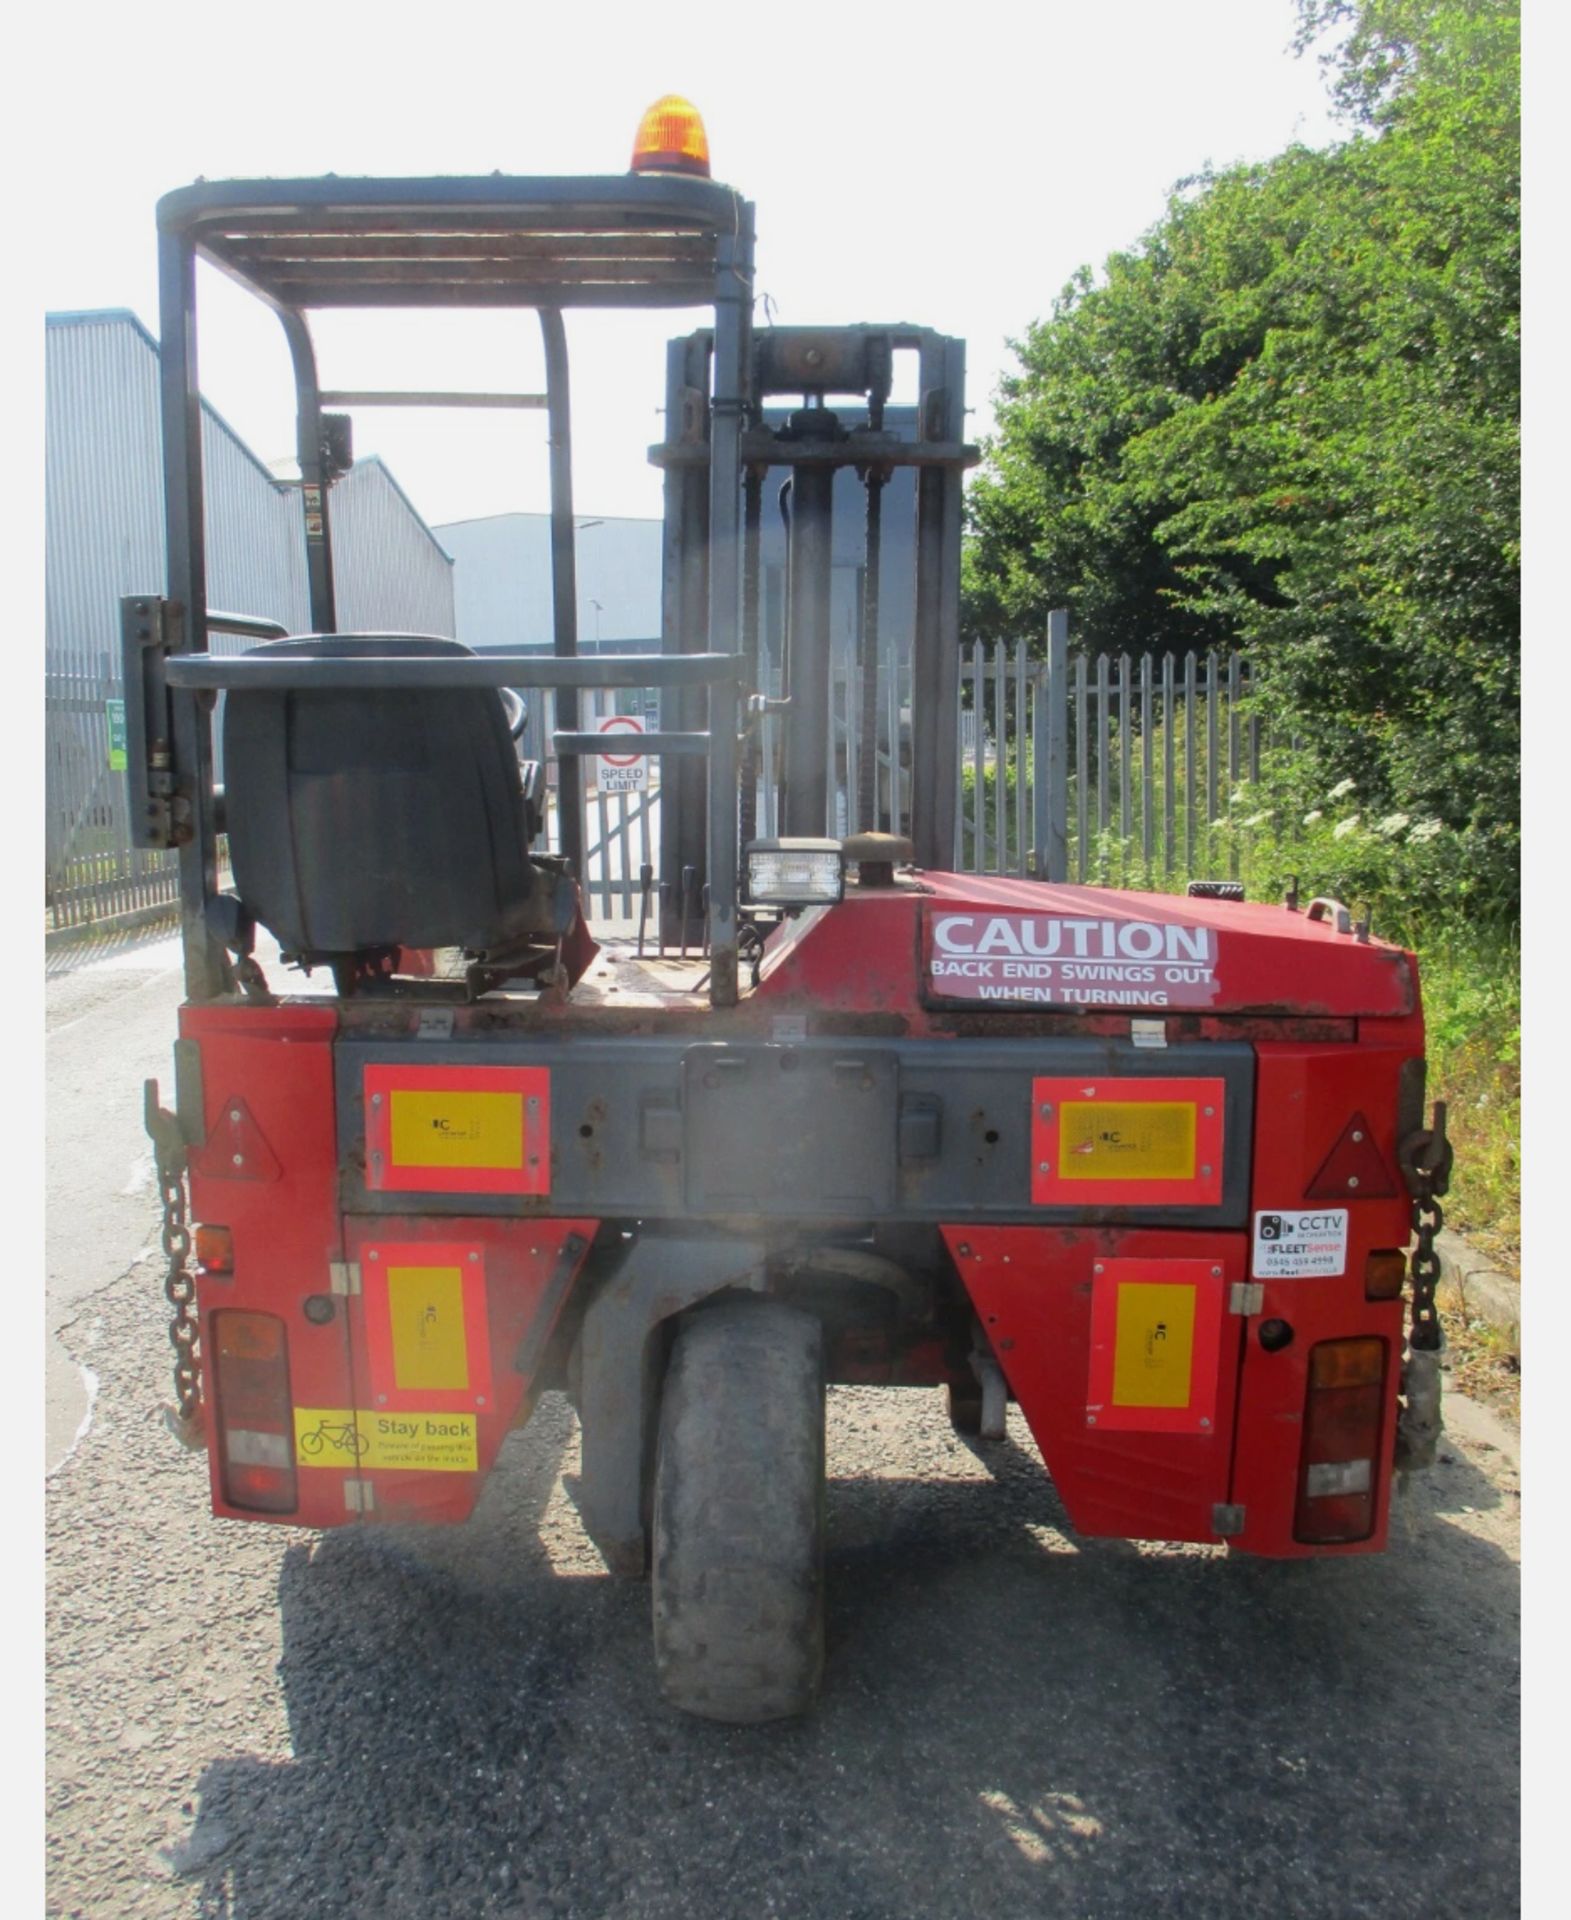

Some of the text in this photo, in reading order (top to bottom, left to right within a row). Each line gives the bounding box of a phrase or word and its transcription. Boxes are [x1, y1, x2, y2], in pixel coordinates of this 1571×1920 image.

[601, 768, 643, 779] SPEED
[606, 780, 638, 790] LIMIT
[934, 916, 1209, 960] CAUTION
[931, 960, 1213, 984] BACK END SWINGS OUT
[979, 986, 1168, 1006] WHEN TURNING
[1298, 1216, 1342, 1231] CCTV
[378, 1419, 471, 1438] Stay back
